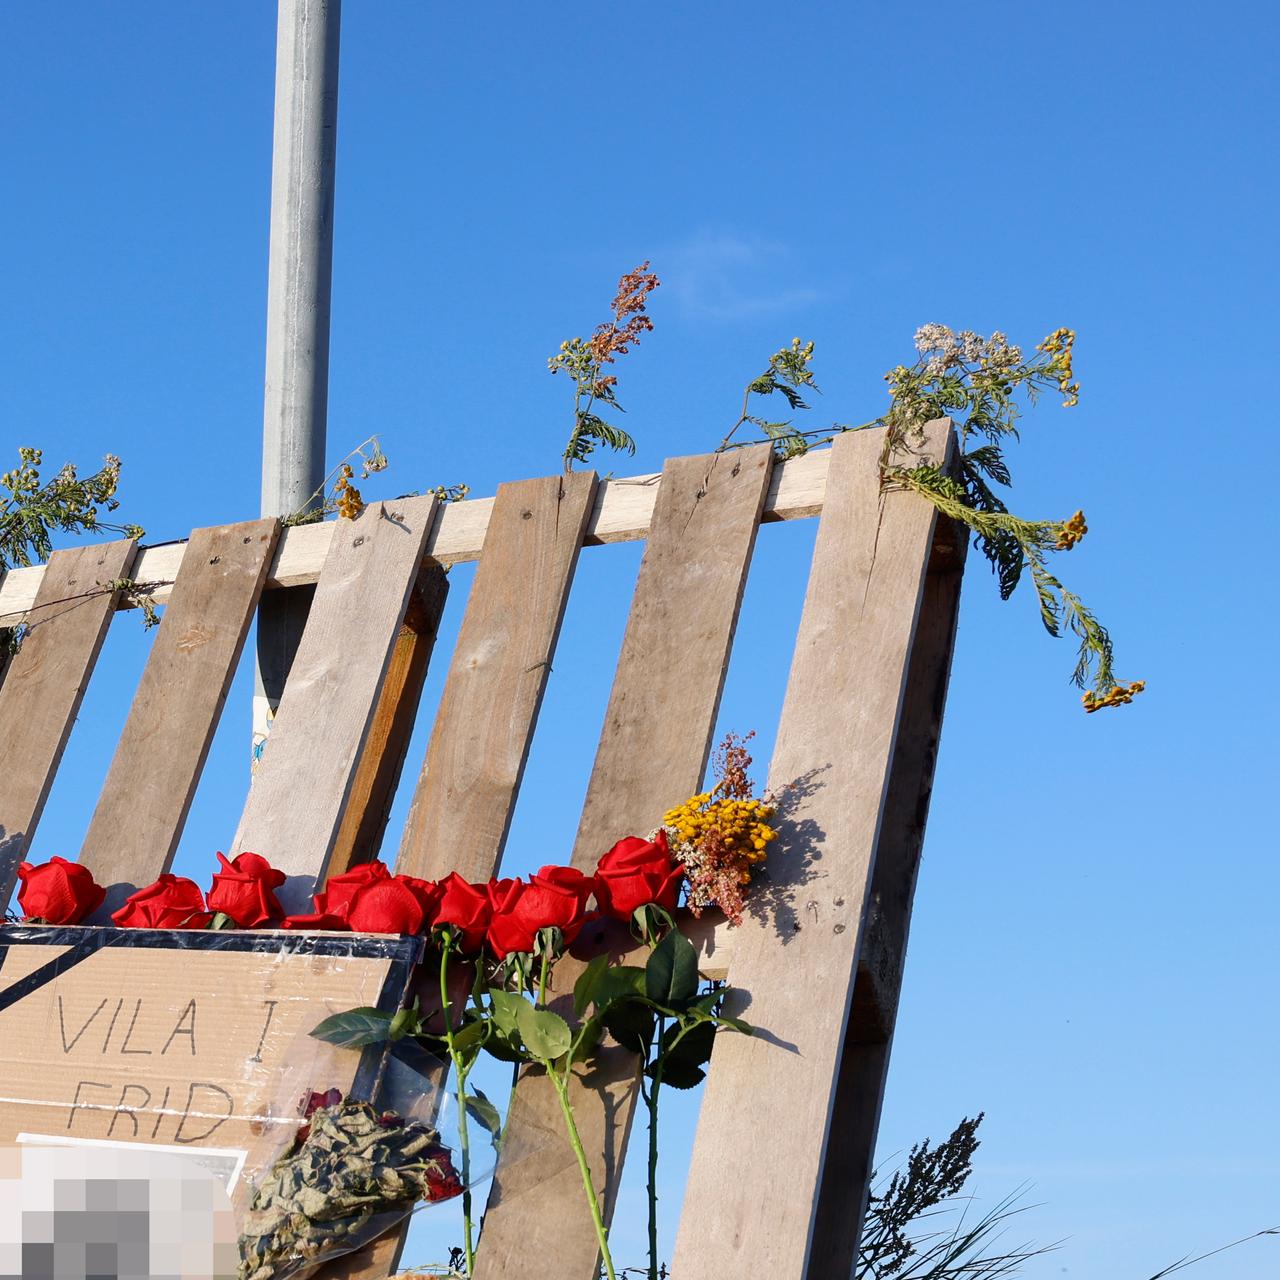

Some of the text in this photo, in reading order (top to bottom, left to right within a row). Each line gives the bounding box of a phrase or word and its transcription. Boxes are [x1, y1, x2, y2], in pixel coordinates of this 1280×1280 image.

[58, 995, 279, 1063] VILA I
[66, 1081, 235, 1144] FRID
